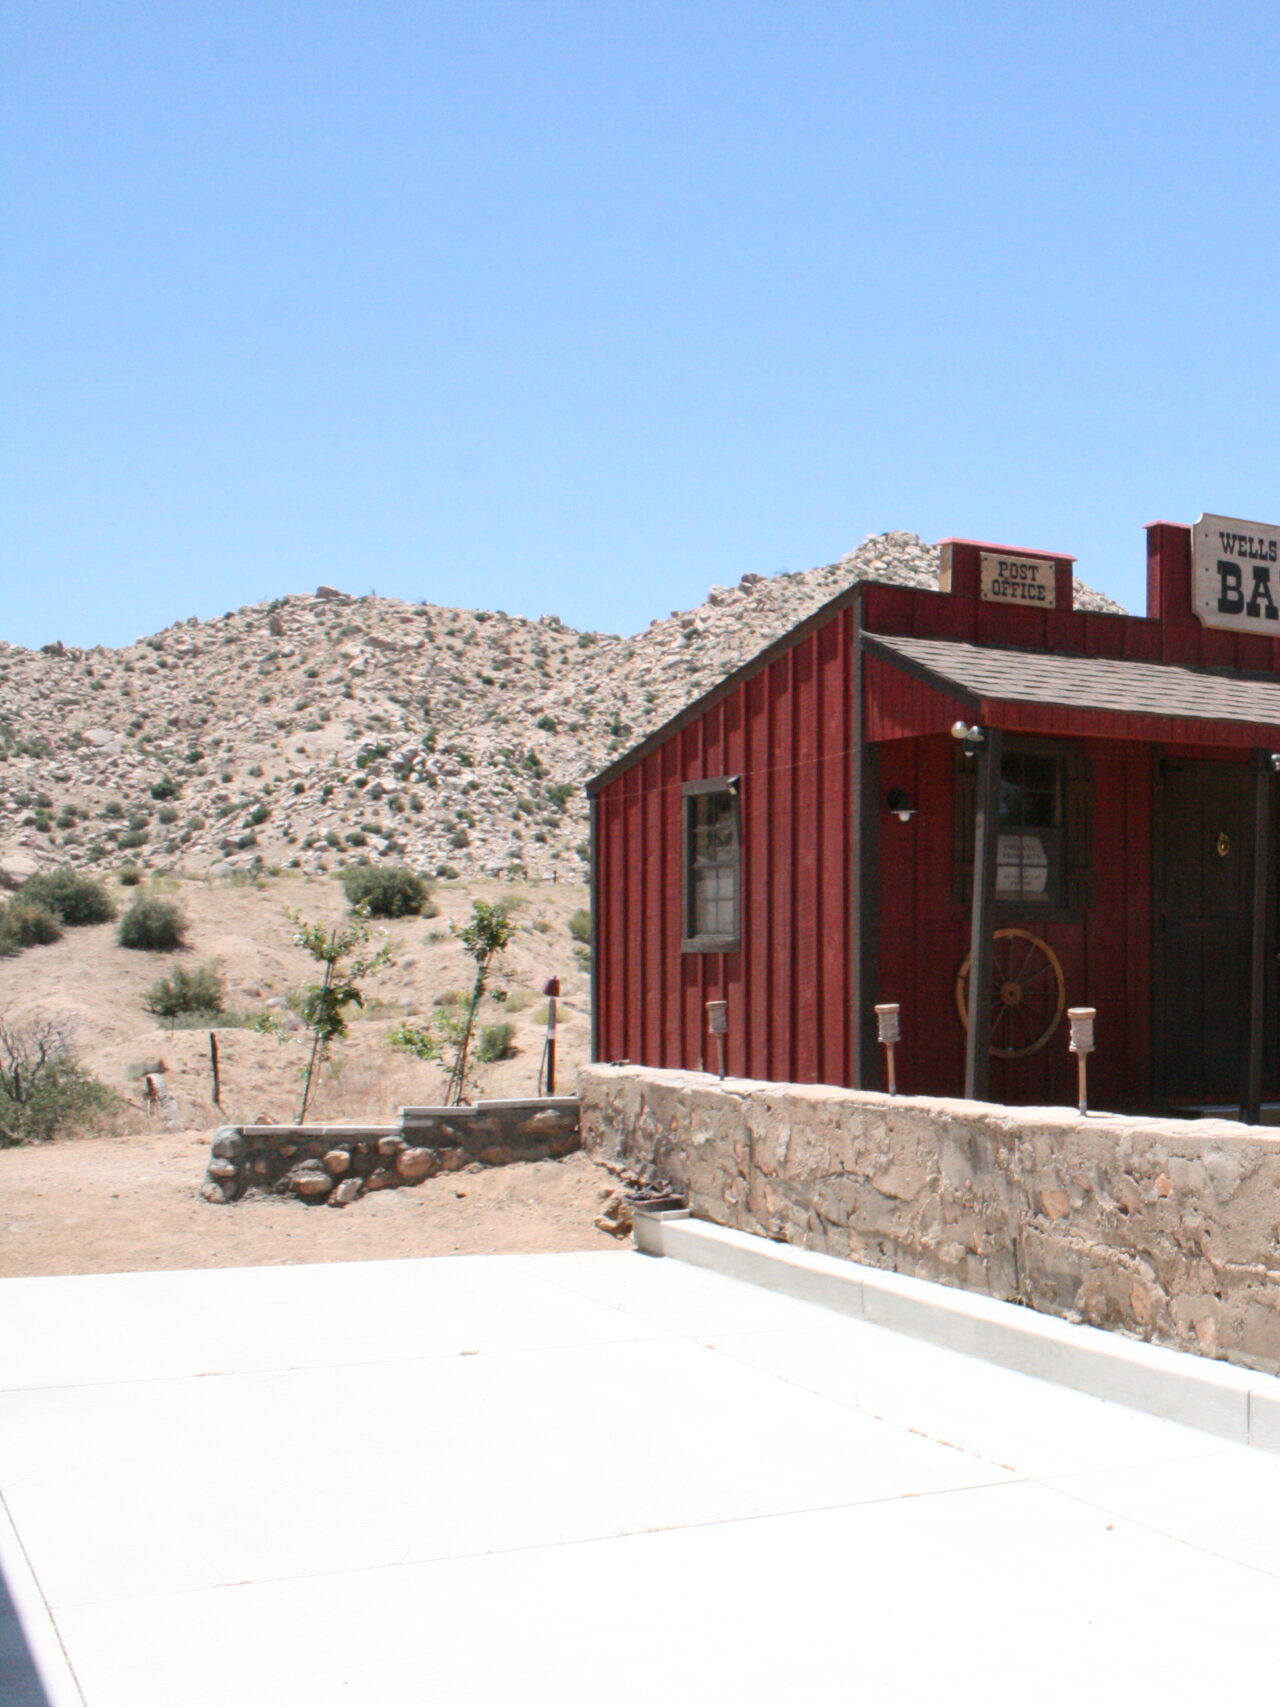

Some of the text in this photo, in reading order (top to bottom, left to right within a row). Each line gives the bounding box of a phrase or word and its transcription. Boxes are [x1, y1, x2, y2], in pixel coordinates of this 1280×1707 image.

[1219, 532, 1278, 562] WELLS
[998, 561, 1038, 581] POST
[992, 579, 1046, 600] OFFICE
